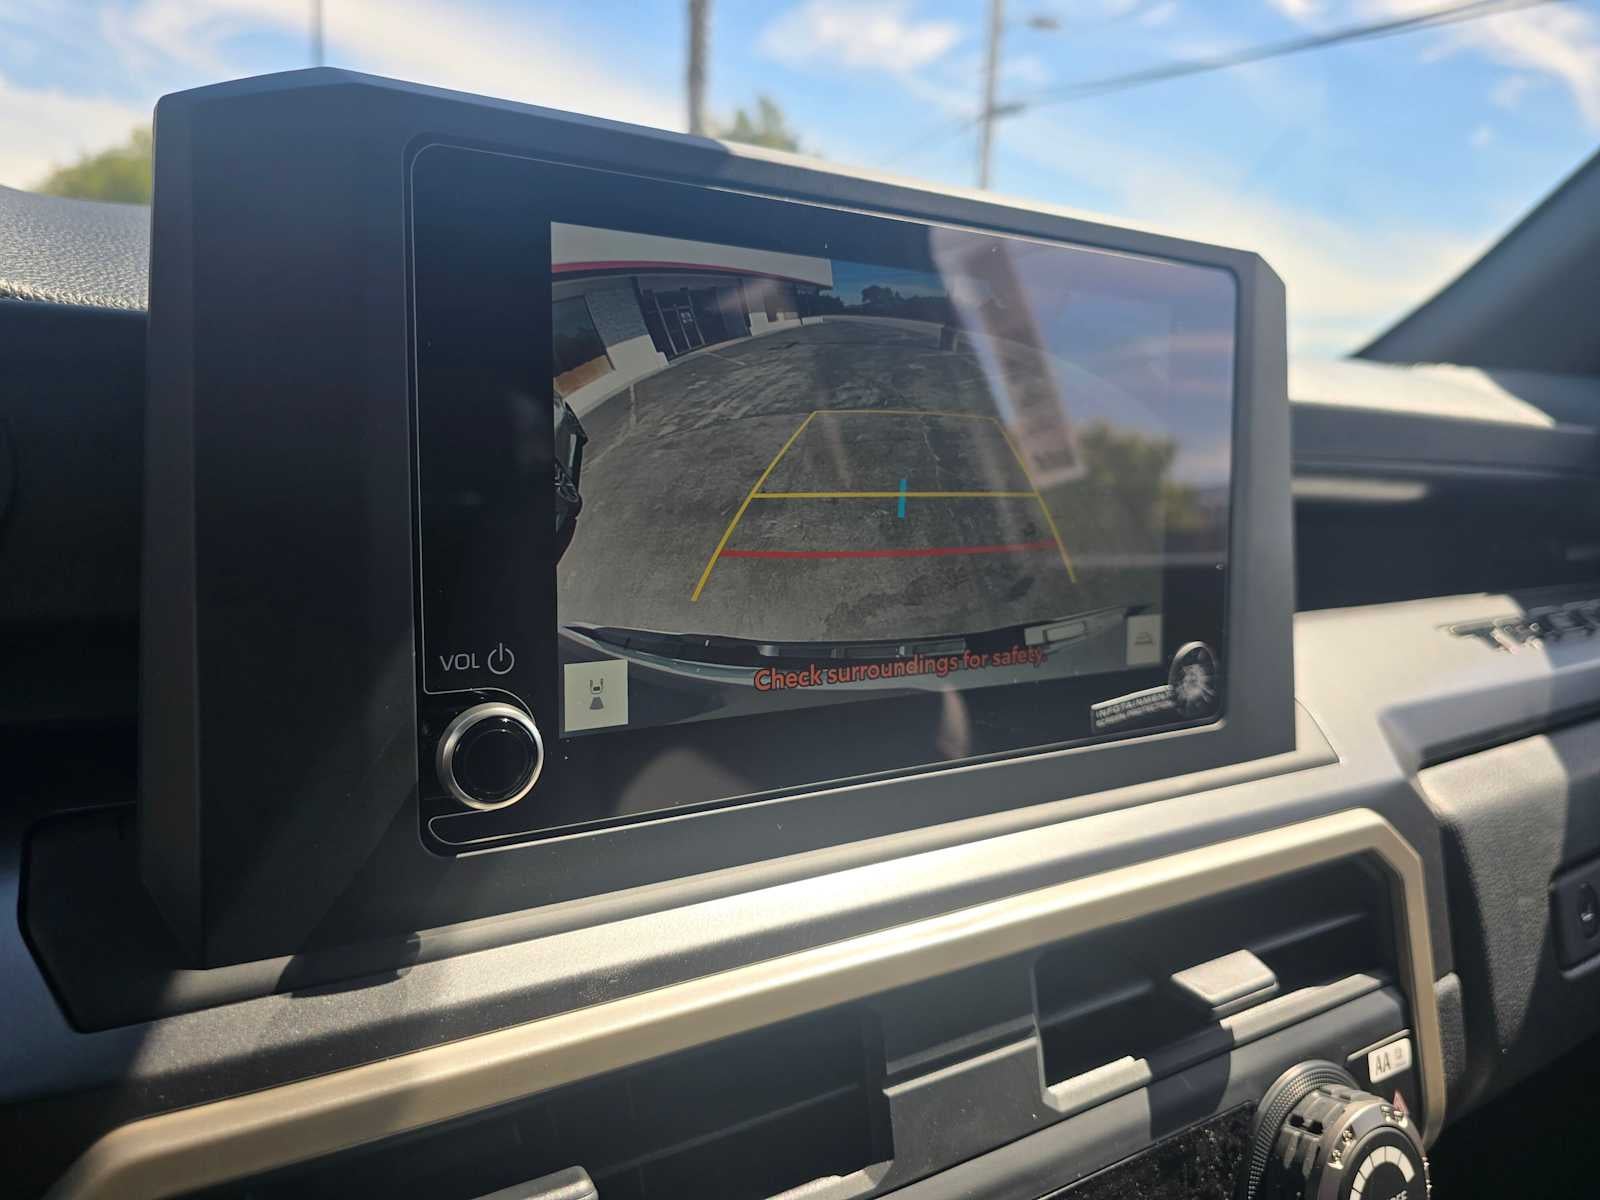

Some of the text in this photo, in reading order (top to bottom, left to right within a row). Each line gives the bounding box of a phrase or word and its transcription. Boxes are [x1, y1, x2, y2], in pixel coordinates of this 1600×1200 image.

[439, 653, 480, 672] VOL
[754, 645, 1048, 691] Check surroundings for safety.
